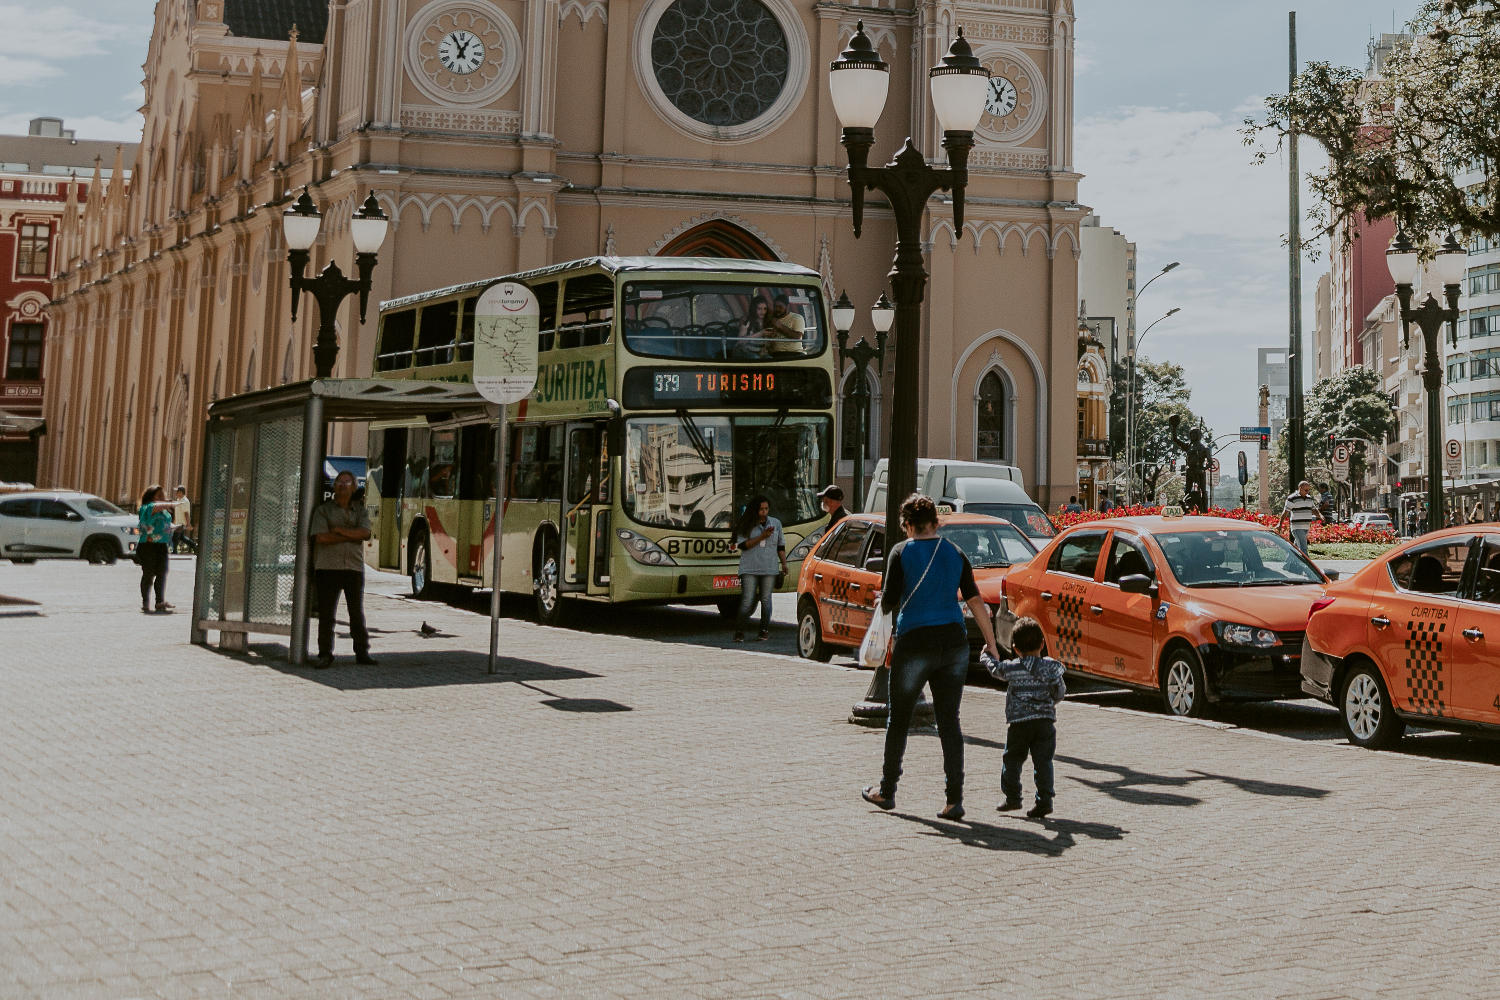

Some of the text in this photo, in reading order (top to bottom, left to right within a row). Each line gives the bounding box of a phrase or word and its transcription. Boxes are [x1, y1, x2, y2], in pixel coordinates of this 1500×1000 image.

[534, 359, 607, 403] CURITIBA
[655, 373, 775, 392] 979 TURISMO
[1339, 449, 1344, 460] E
[1450, 443, 1456, 454] E
[1062, 582, 1087, 594] CURITIBA
[1412, 607, 1448, 618] CURITIBA
[1114, 657, 1126, 672] 96
